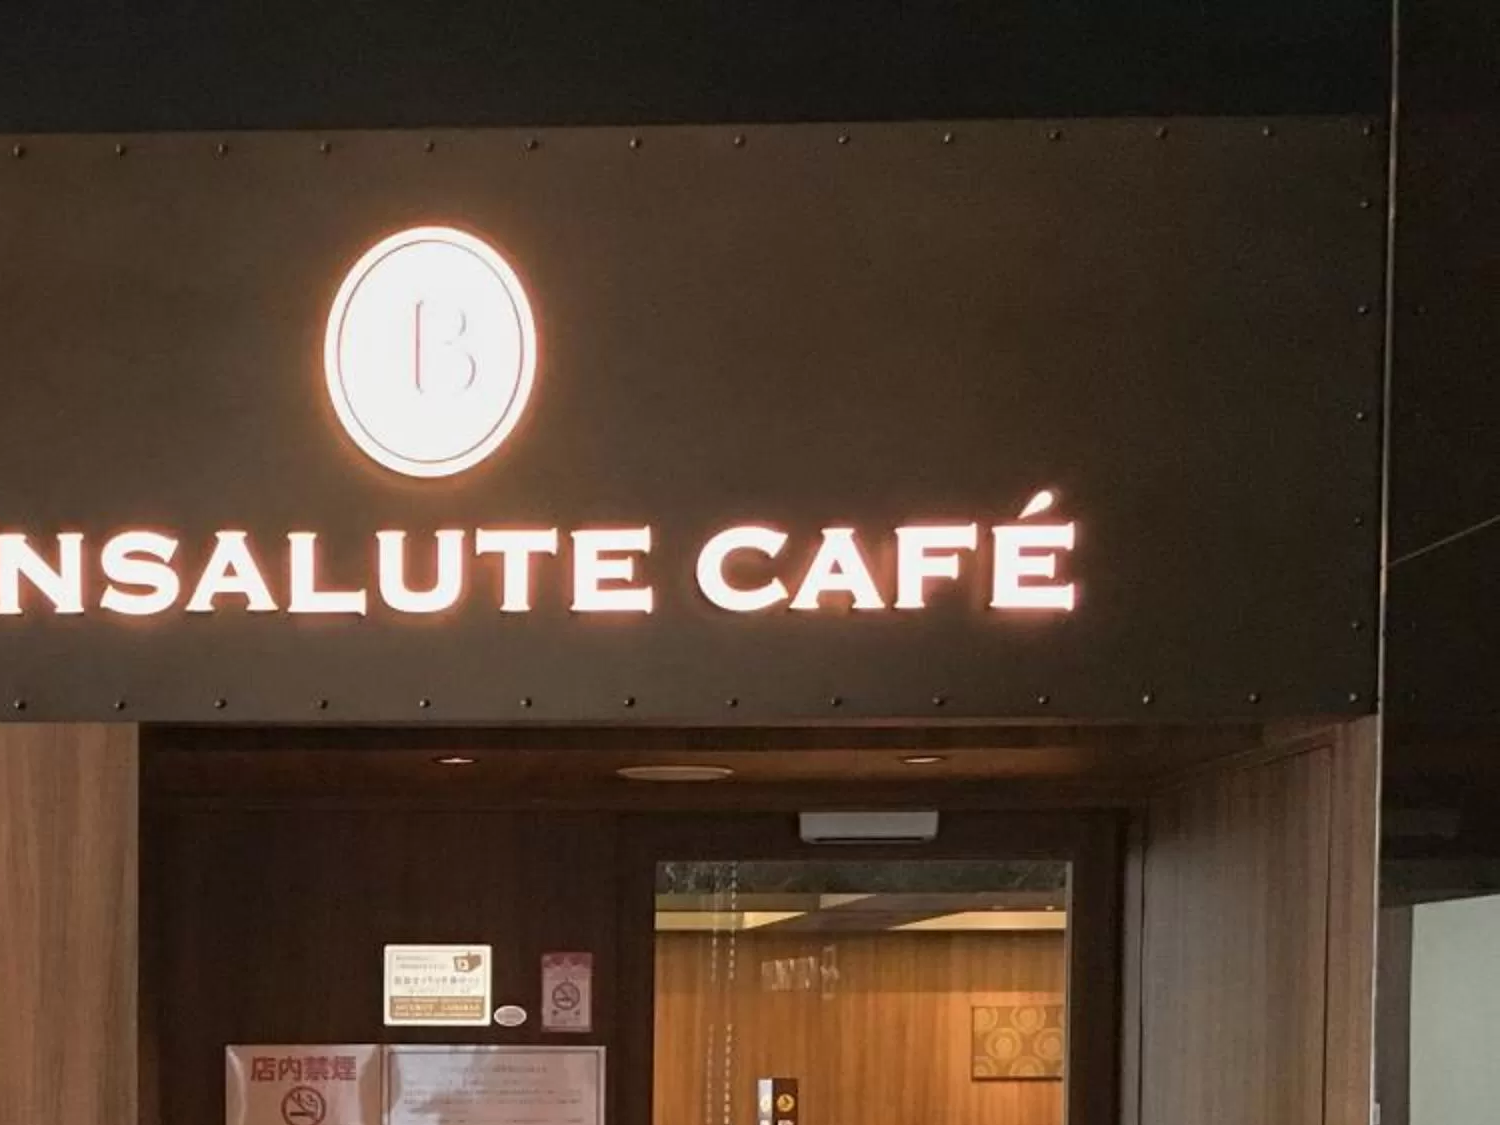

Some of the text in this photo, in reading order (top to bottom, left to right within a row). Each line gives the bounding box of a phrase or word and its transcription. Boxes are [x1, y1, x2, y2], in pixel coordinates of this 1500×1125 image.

[696, 489, 1078, 612] CAFÉ
[250, 1055, 357, 1082] 店内禁煙
